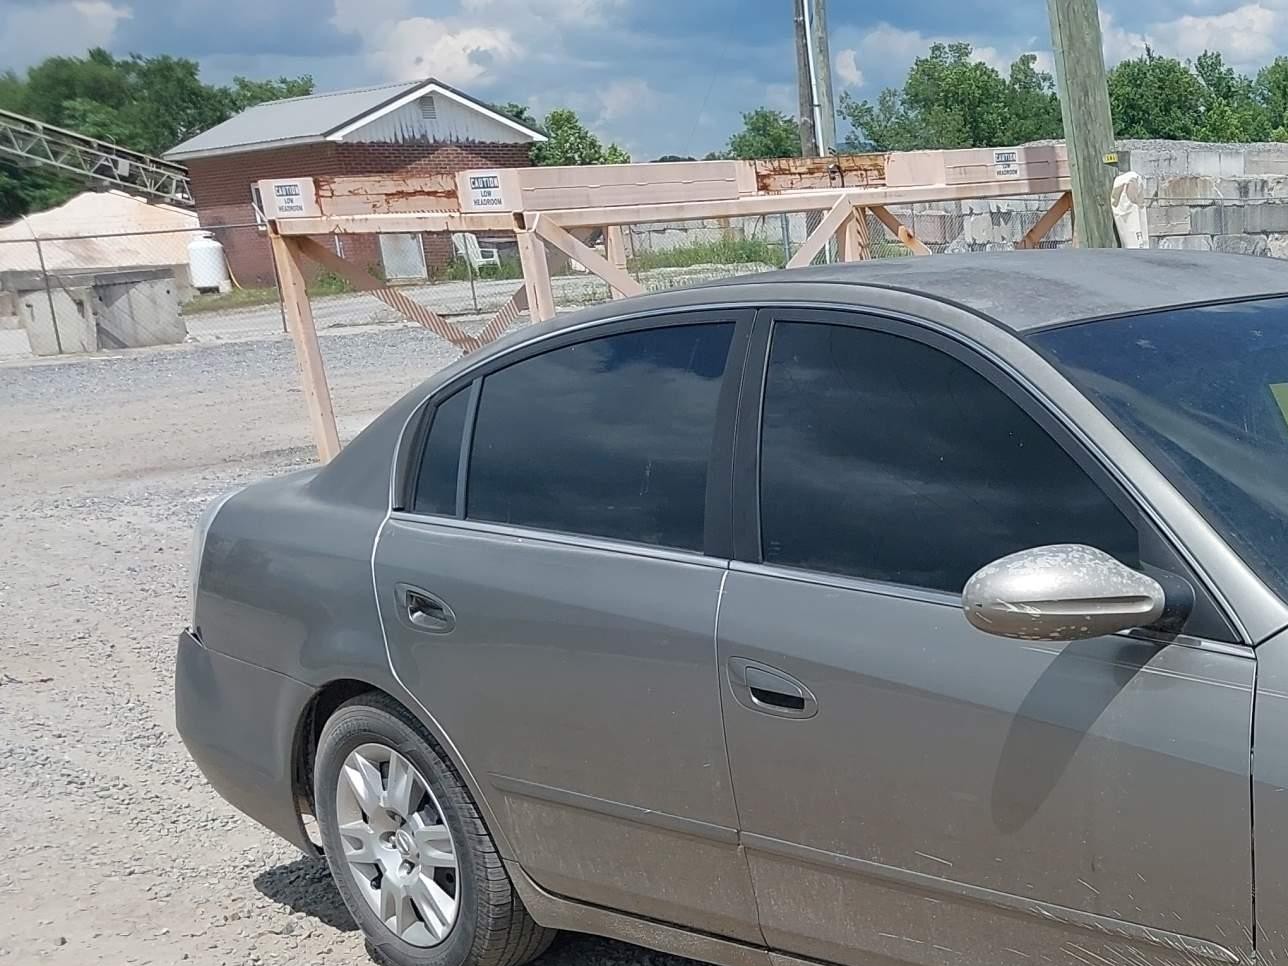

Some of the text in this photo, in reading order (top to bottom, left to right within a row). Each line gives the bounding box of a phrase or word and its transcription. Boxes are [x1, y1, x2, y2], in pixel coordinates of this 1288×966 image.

[995, 152, 1017, 162] CAUTION
[470, 176, 499, 189] CAUTION
[274, 185, 300, 196] CAUTION
[474, 198, 502, 206] HEADROOM
[279, 205, 303, 213] HEADROOM
